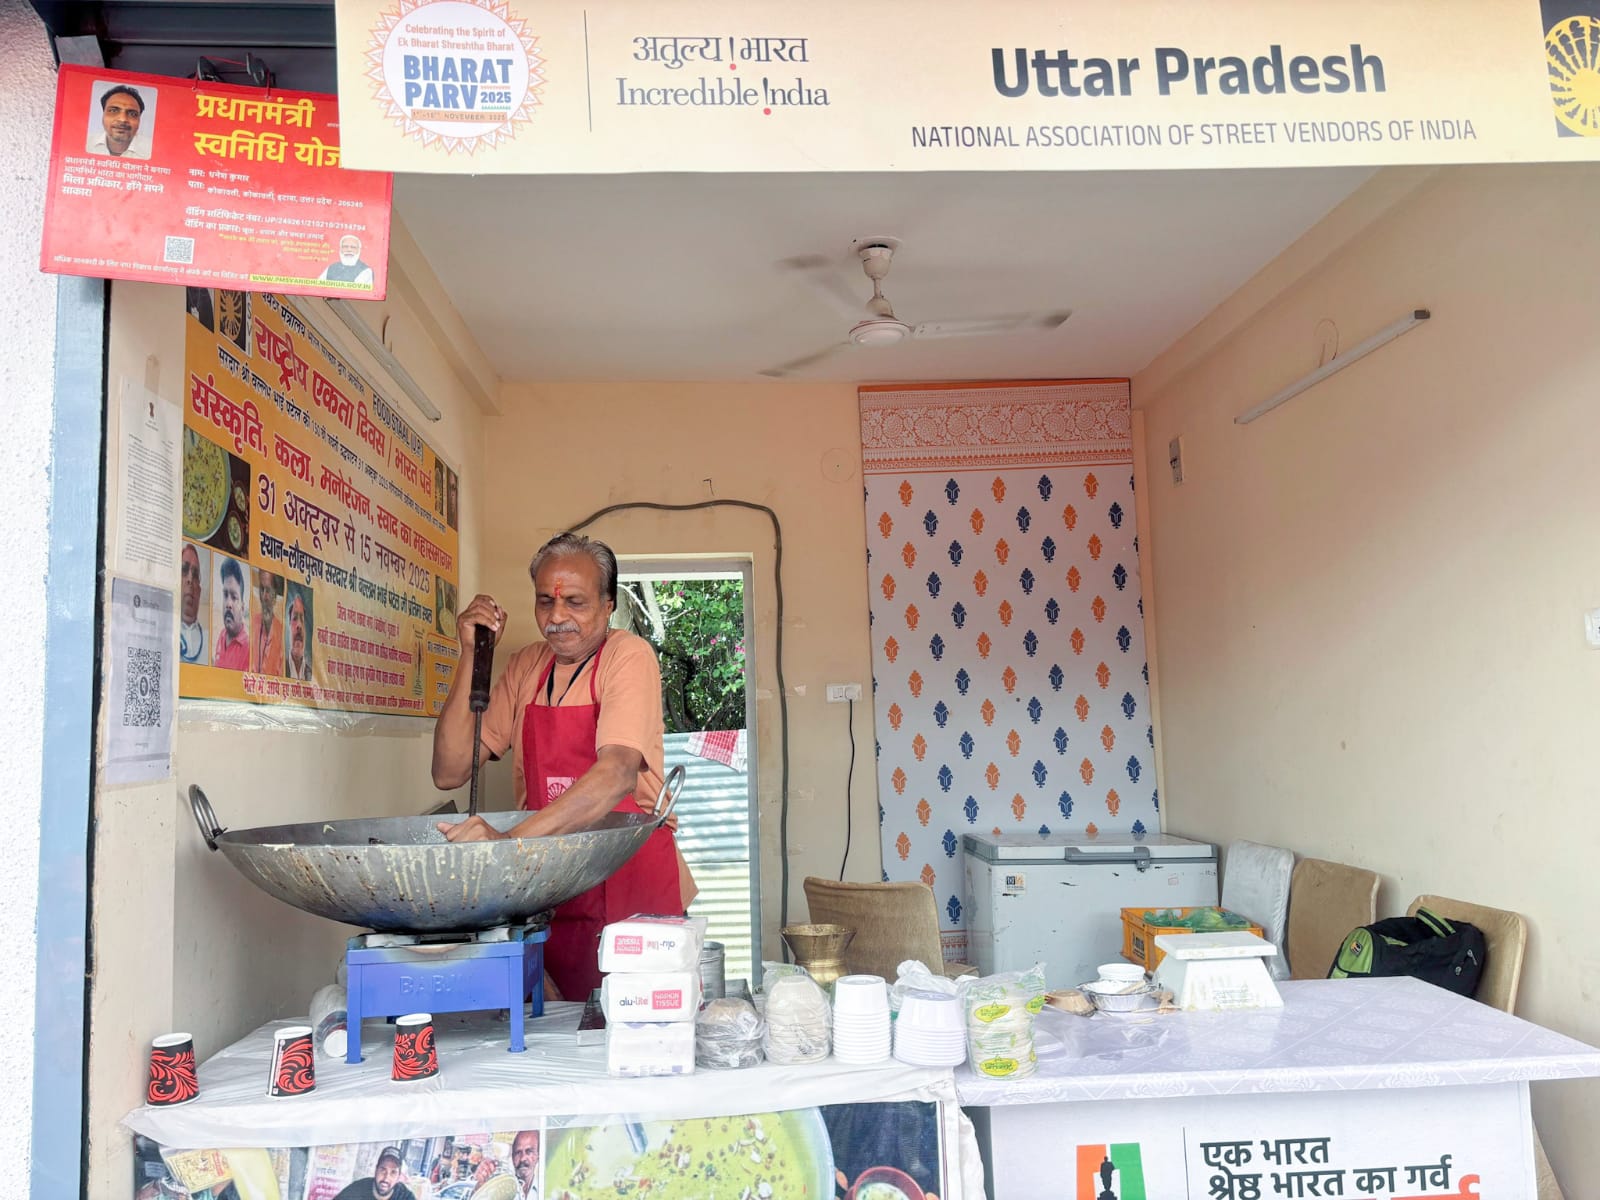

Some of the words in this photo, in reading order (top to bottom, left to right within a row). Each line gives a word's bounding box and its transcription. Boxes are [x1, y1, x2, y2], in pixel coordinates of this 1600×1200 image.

[398, 38, 409, 47] Ek
[411, 38, 439, 48] Bharat
[441, 39, 485, 50] Shreshtha
[487, 41, 514, 51] Bharat
[405, 24, 454, 38] Celebrating
[456, 27, 470, 37] the
[473, 27, 495, 38] Spirit
[497, 28, 505, 37] of
[403, 54, 513, 84] BHARAT
[991, 47, 1140, 98] Uttar
[1155, 44, 1386, 96] Pradesh
[404, 82, 478, 109] PARV
[480, 91, 512, 104] 2025
[615, 77, 759, 106] Incredible
[195, 94, 316, 129] प्रधानमंत्री
[444, 113, 485, 121] NOVEMBER
[193, 129, 289, 163] स्वनिधि
[294, 136, 340, 168] योज
[911, 125, 1020, 147] NATIONAL
[1025, 125, 1162, 147] ASSOCIATION
[1168, 124, 1194, 145] OF
[1201, 122, 1277, 145] STREET
[1283, 121, 1382, 143] VENDORS
[1388, 120, 1414, 141] OF
[1420, 119, 1477, 141] INDIA
[217, 346, 241, 375] सरदार
[241, 362, 251, 383] श्री
[285, 395, 302, 424] पटेल
[254, 315, 310, 392] राष्ट्रीय
[312, 370, 355, 430] एकता
[357, 401, 386, 458] दिवस
[395, 446, 418, 487] भारत
[419, 468, 432, 498] पर्व
[190, 373, 269, 458] संस्कृति,
[274, 432, 315, 488] कला,
[320, 463, 374, 525] मनोरंजन,
[376, 504, 399, 539] स्वाद
[400, 521, 413, 548] का
[258, 474, 276, 515] 31
[283, 489, 340, 552] अक्टूबर
[344, 513, 357, 553] से
[360, 533, 372, 565] 15
[408, 558, 431, 594] 2025
[325, 560, 348, 591] सरदार
[348, 566, 357, 593] श्री
[619, 996, 649, 1006] alu-lite
[1200, 1140, 1253, 1167] एक
[1260, 1136, 1331, 1166] भारत
[1208, 1165, 1263, 1200] श्रेष्ठ
[1270, 1169, 1346, 1198] भारत
[1353, 1166, 1397, 1194] का
[1404, 1153, 1452, 1191] गर्व
